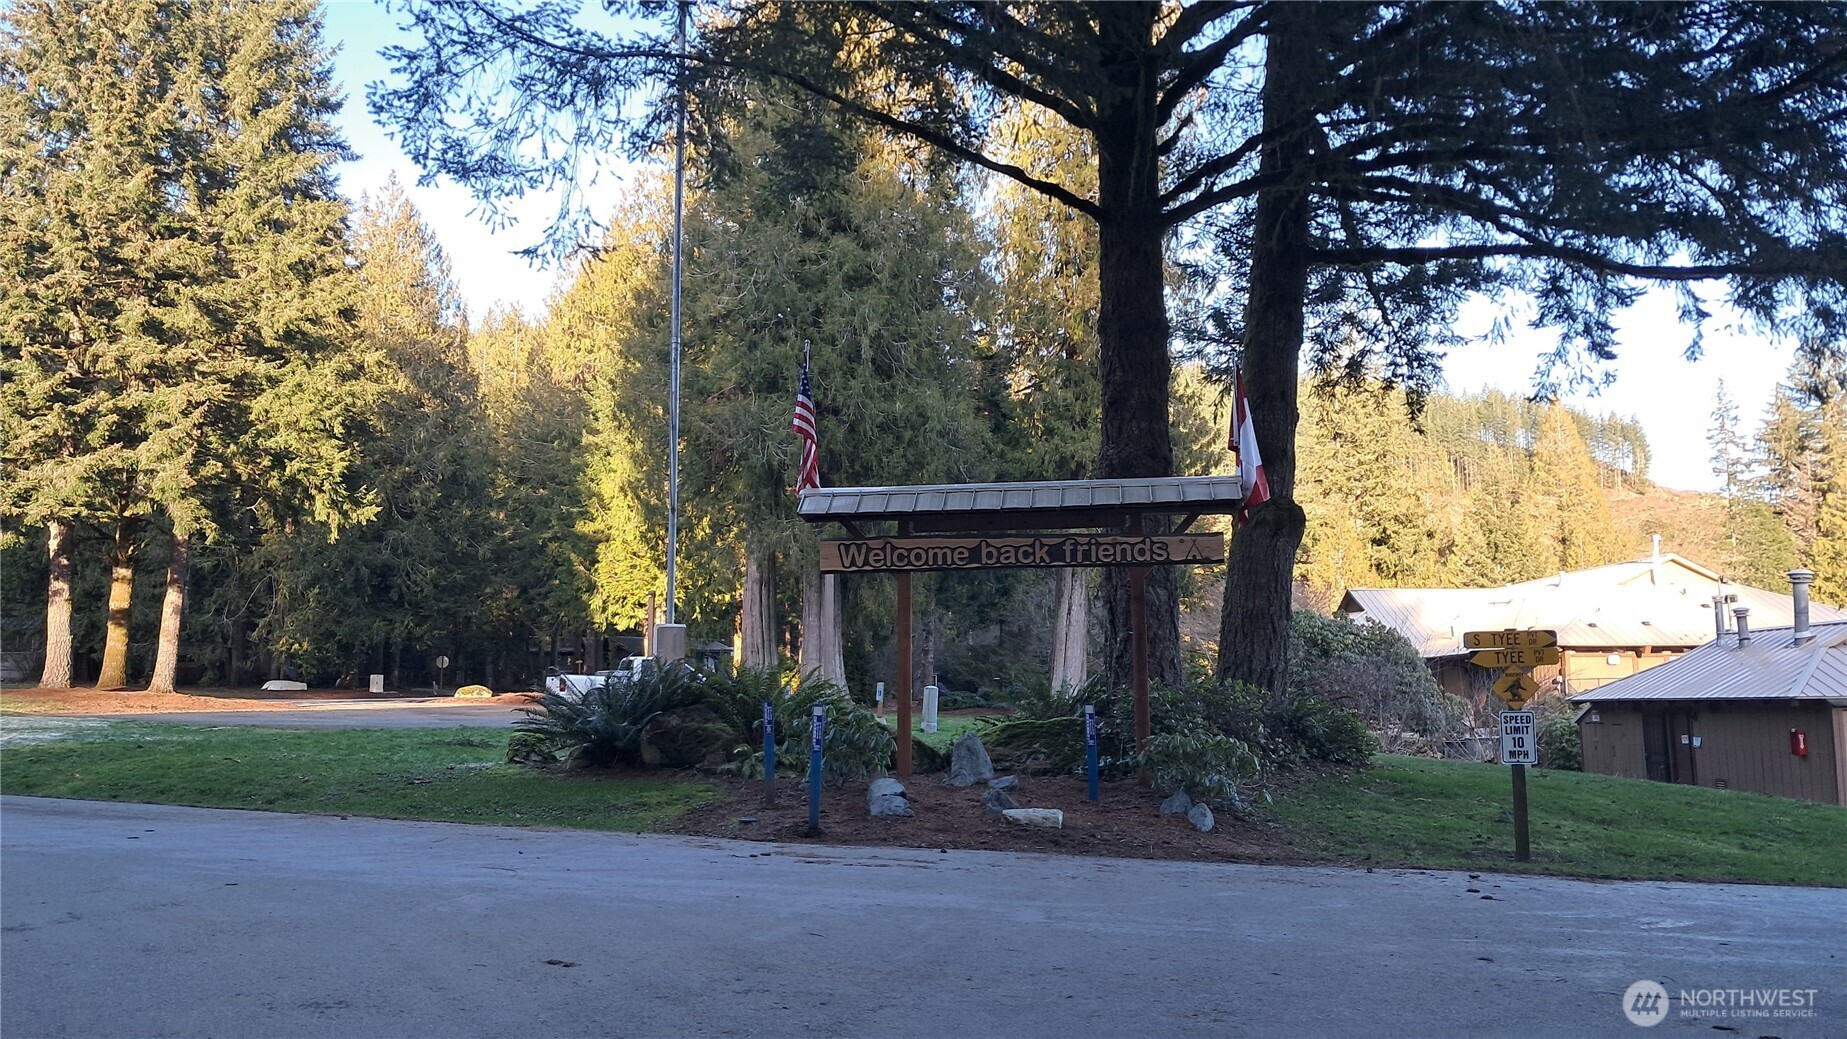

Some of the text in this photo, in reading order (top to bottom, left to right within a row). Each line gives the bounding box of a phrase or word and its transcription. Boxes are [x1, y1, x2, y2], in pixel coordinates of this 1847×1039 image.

[838, 538, 1169, 568] Welcome back friends
[1473, 633, 1521, 646] S TYEE
[1494, 651, 1525, 664] TYEE
[1503, 715, 1531, 725] SPEED
[1505, 725, 1530, 735] LIMIT
[1511, 736, 1524, 748] 10
[1509, 750, 1529, 759] MPH
